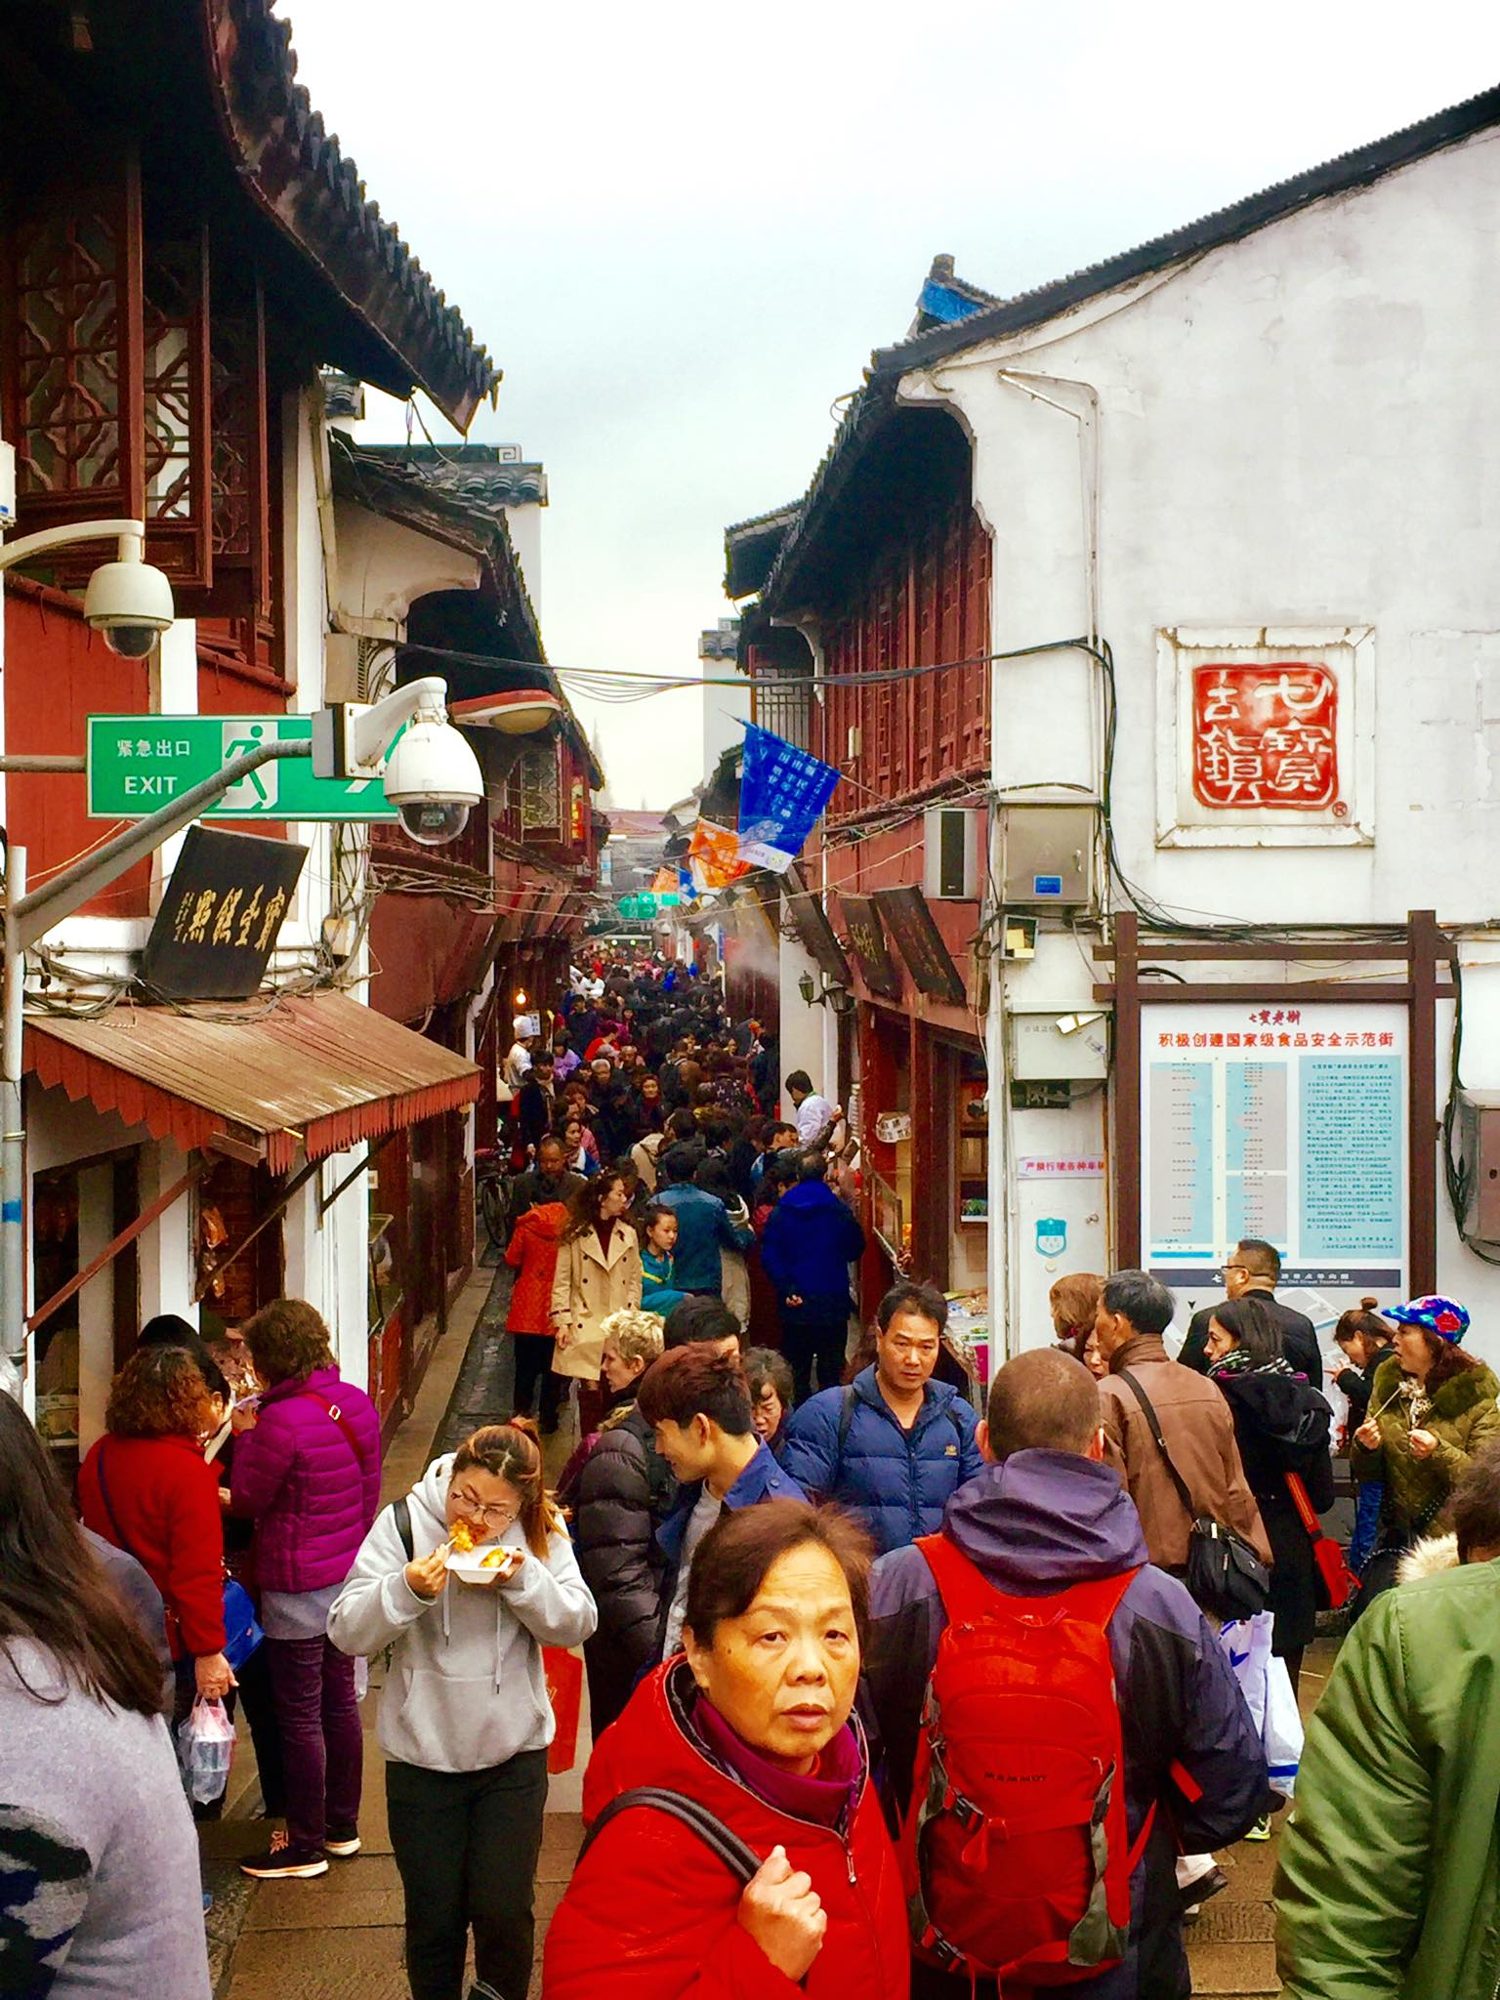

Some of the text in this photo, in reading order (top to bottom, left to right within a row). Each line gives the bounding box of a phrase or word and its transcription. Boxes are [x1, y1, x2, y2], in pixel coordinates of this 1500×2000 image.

[117, 739, 191, 757] 紧急出口
[125, 776, 177, 795] EXIT
[1158, 1032, 1395, 1048] 积极创建国家级食品安全示范街
